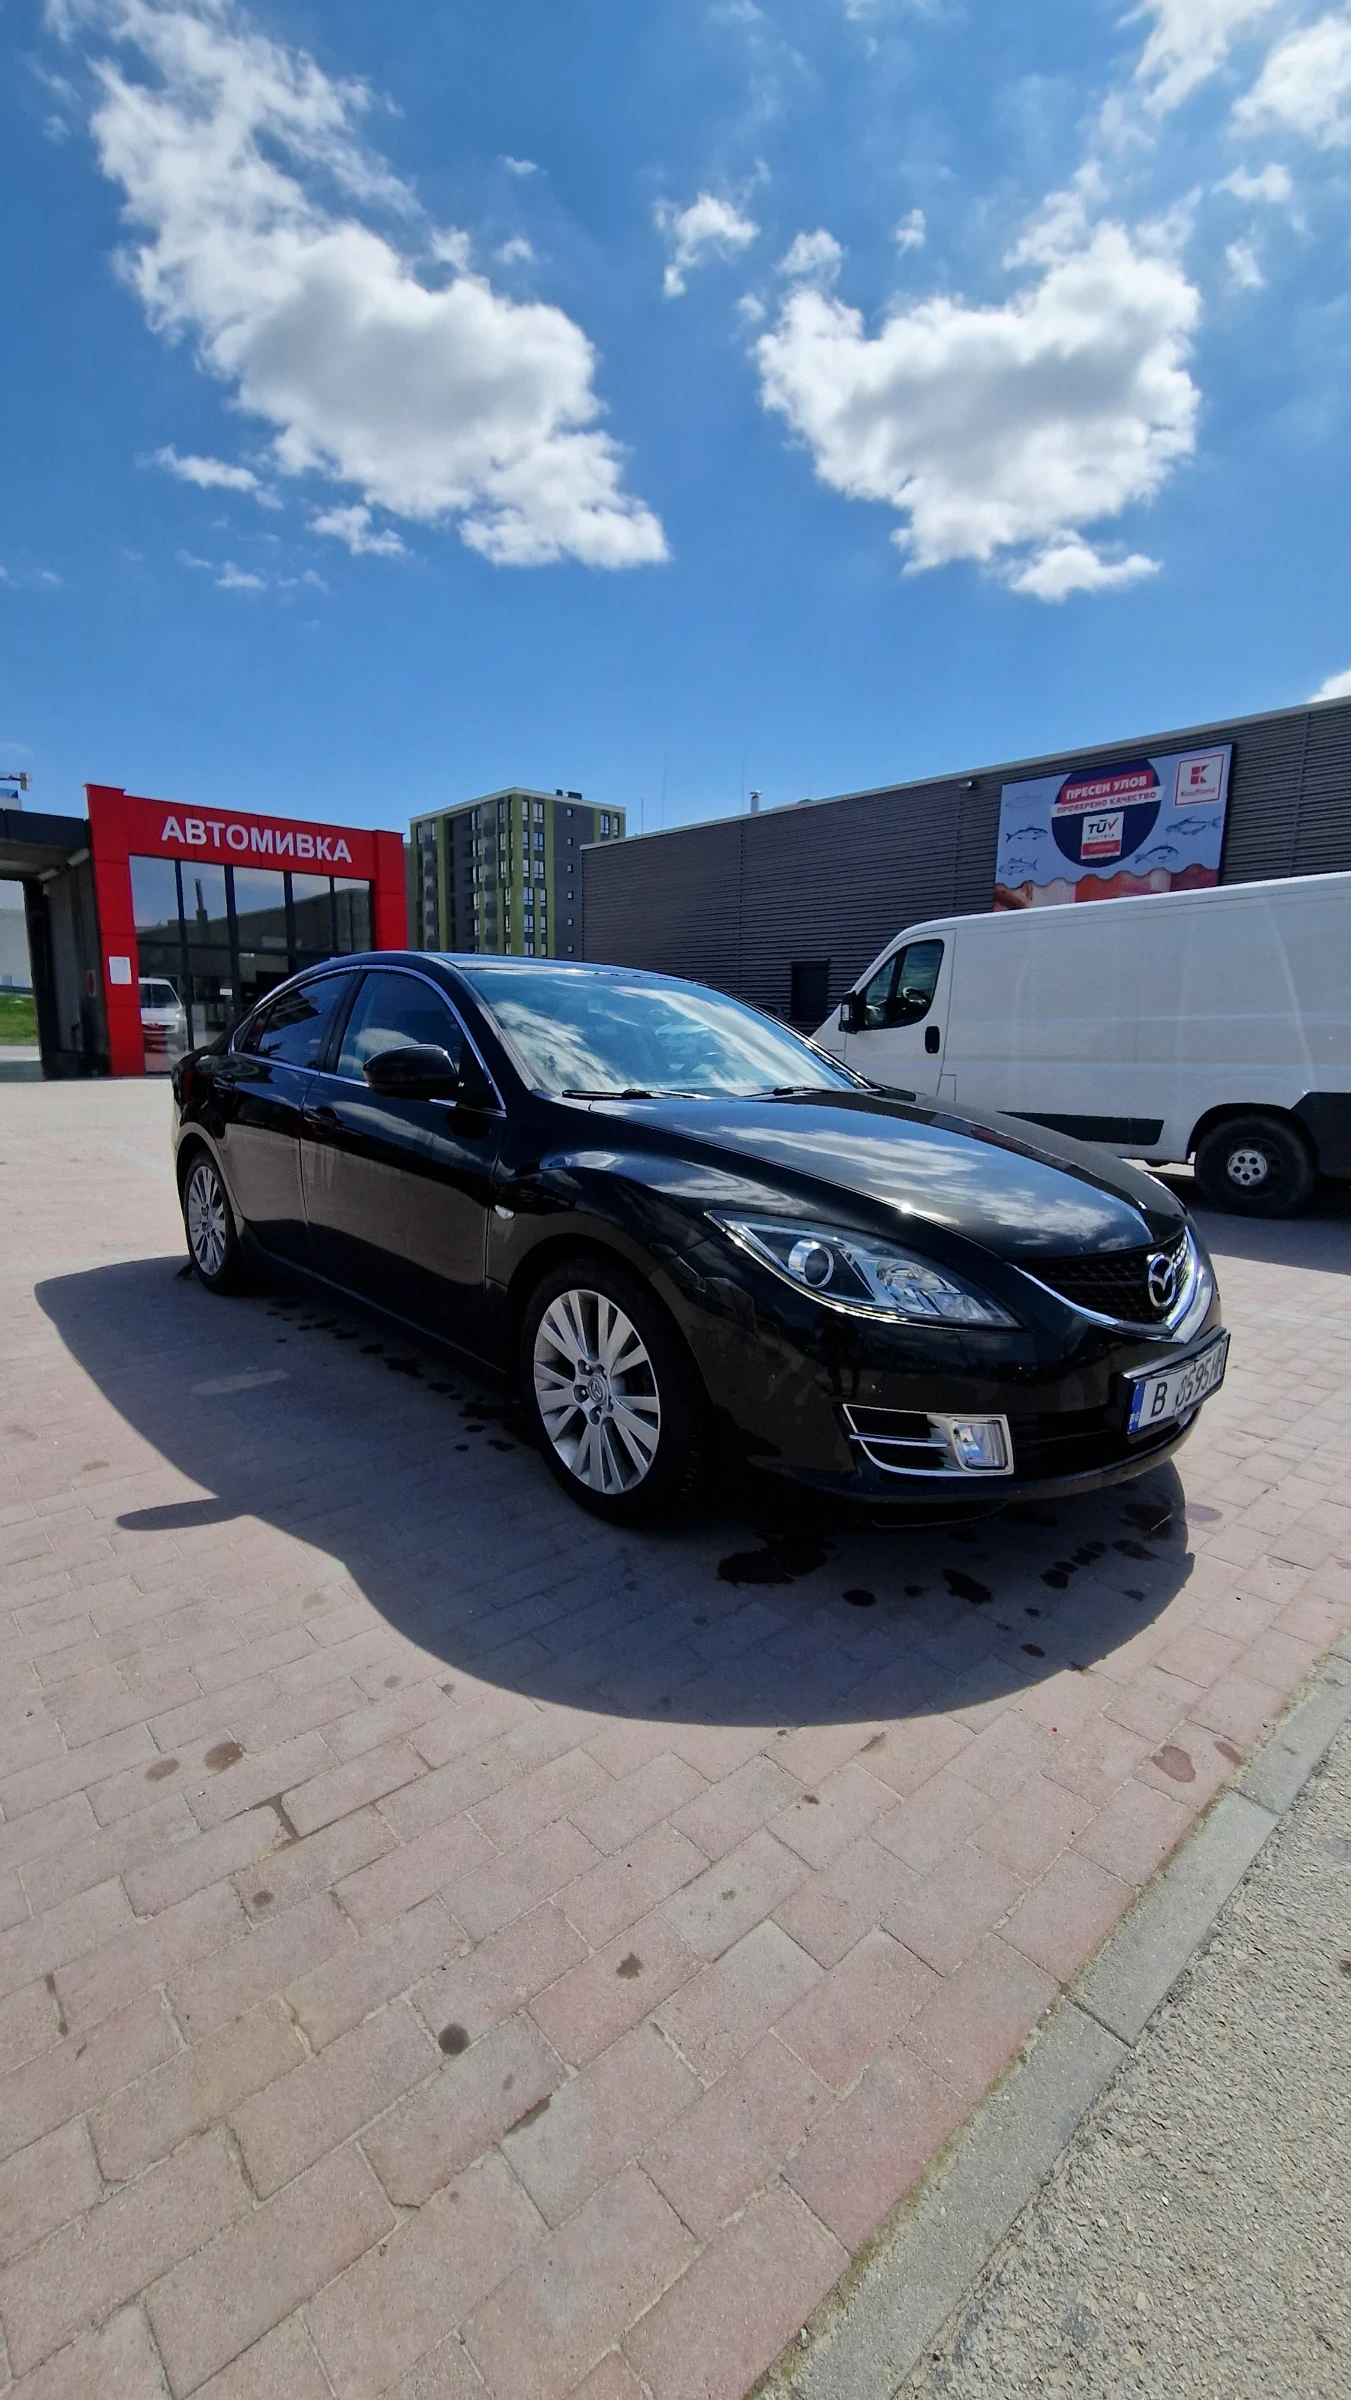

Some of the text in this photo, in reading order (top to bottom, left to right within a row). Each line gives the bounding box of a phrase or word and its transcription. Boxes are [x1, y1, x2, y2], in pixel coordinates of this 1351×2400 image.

[1057, 791, 1157, 814] ПРОВЕРЕНО КАЧЕСТВО
[1066, 776, 1147, 800] ПРЕСЕН УЛОВ
[161, 816, 353, 863] АВТОМИВКА
[1151, 1382, 1168, 1417] B
